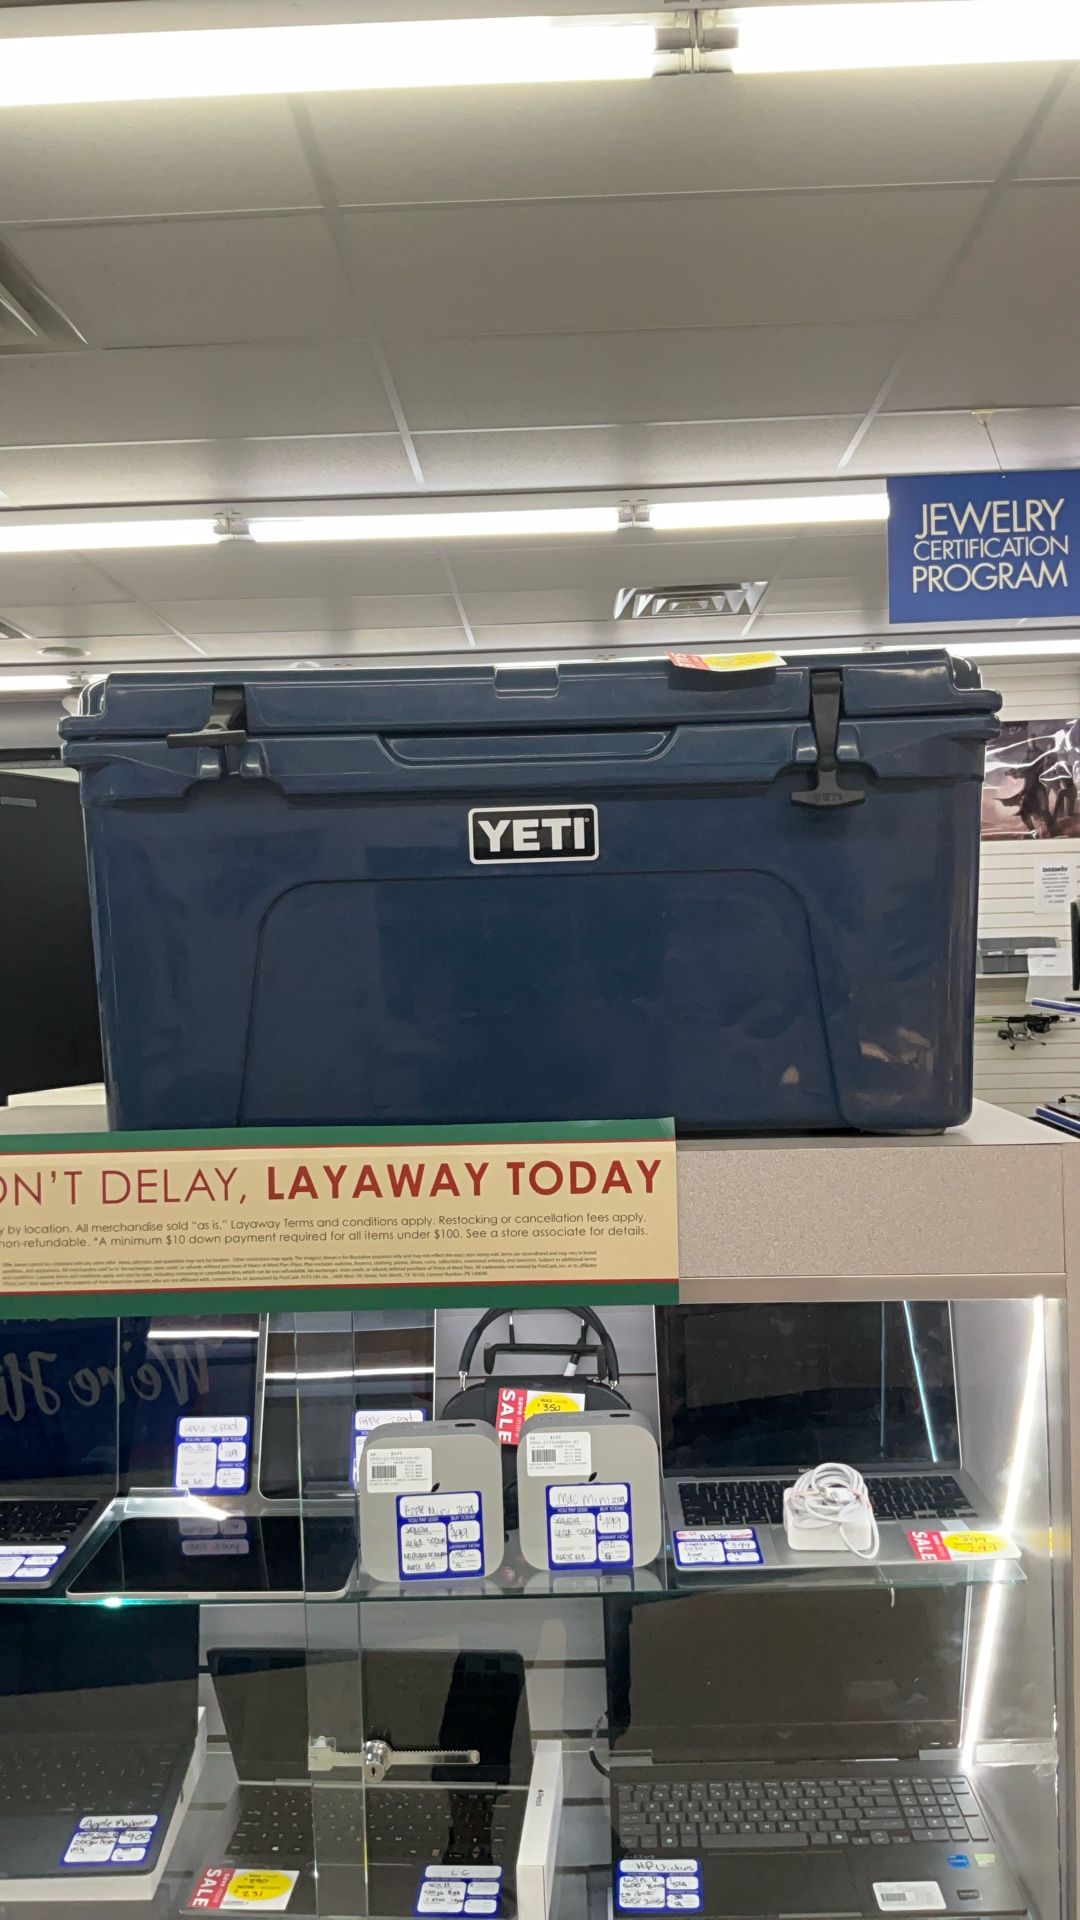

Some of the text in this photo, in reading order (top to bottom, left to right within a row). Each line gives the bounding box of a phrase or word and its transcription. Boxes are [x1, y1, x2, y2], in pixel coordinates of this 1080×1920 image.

[914, 498, 1065, 539] JEWELRY
[913, 535, 1069, 561] CERTIFICATION
[912, 560, 1068, 593] PROGRAM
[477, 817, 585, 852] YETI
[102, 1168, 248, 1206] DELAY,
[267, 1163, 488, 1200] LAYAWAY
[507, 1159, 662, 1196] TODAY
[7, 1224, 21, 1237] by
[24, 1223, 72, 1234] location.
[75, 1223, 88, 1233] All
[91, 1221, 163, 1233] merchandise
[166, 1220, 188, 1231] sold
[230, 1218, 281, 1231] Layaway
[284, 1218, 314, 1228] Terms
[317, 1217, 339, 1228] and
[342, 1216, 398, 1227] conditions
[401, 1216, 435, 1229] apply.
[438, 1214, 498, 1226] Restocking
[501, 1215, 512, 1224] or
[515, 1213, 584, 1224] cancellation
[586, 1212, 609, 1223] fees
[612, 1211, 647, 1225] apply.
[110, 1235, 162, 1245] minimum
[166, 1234, 186, 1246] $10
[189, 1234, 221, 1244] down
[224, 1233, 276, 1245] payment
[279, 1231, 327, 1244] required
[330, 1230, 345, 1241] for
[348, 1230, 361, 1240] all
[364, 1230, 394, 1240] items
[397, 1229, 430, 1240] under
[434, 1228, 462, 1240] $100.
[466, 1228, 487, 1238] See
[490, 1229, 498, 1238] a
[501, 1227, 528, 1237] store
[532, 1226, 586, 1237] associate
[590, 1225, 604, 1236] for
[608, 1225, 648, 1236] details.
[498, 1389, 516, 1443] SALE
[912, 1531, 938, 1560] SALE
[192, 1868, 222, 1907] SALE
